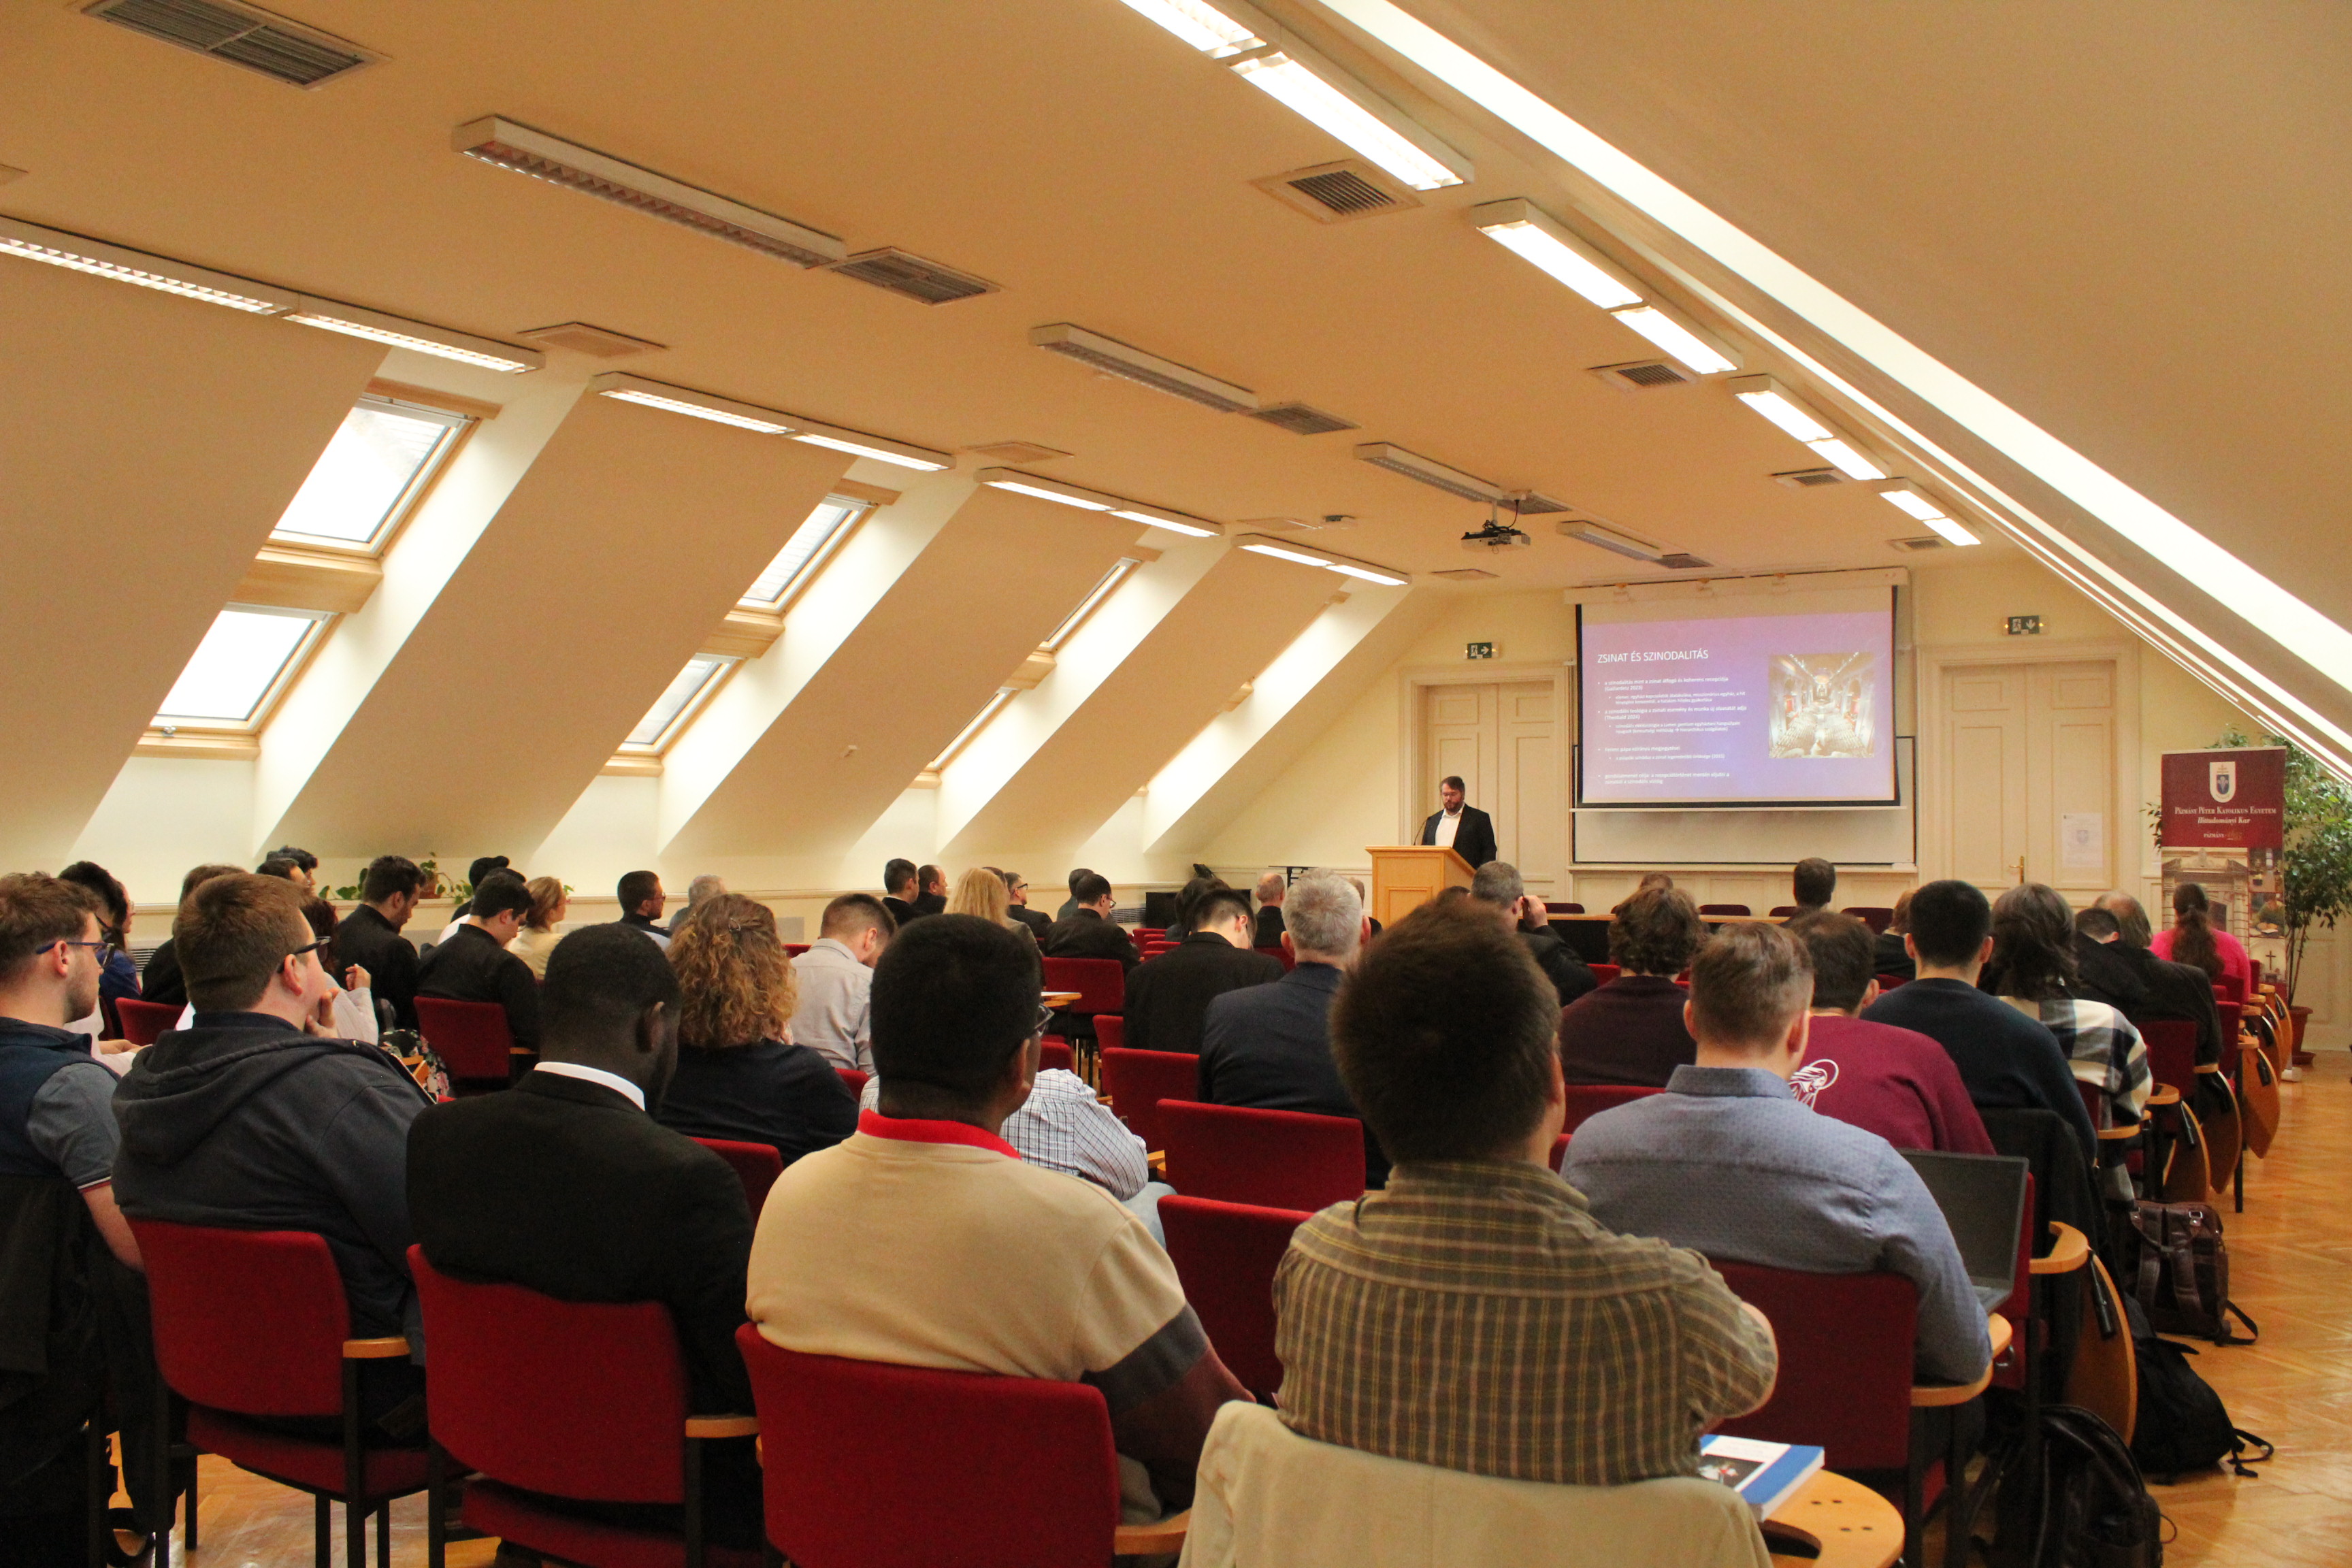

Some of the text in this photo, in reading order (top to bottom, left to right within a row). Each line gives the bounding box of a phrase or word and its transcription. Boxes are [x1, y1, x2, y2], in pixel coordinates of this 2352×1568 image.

[1597, 648, 1709, 664] ZSINAT ÉS SZINODALITÁS
[2198, 806, 2215, 815] PÉTER
[2217, 806, 2248, 814] KATOLIKUS
[2250, 805, 2277, 814] EGYETEM
[2198, 816, 2237, 826] Hittudományi
